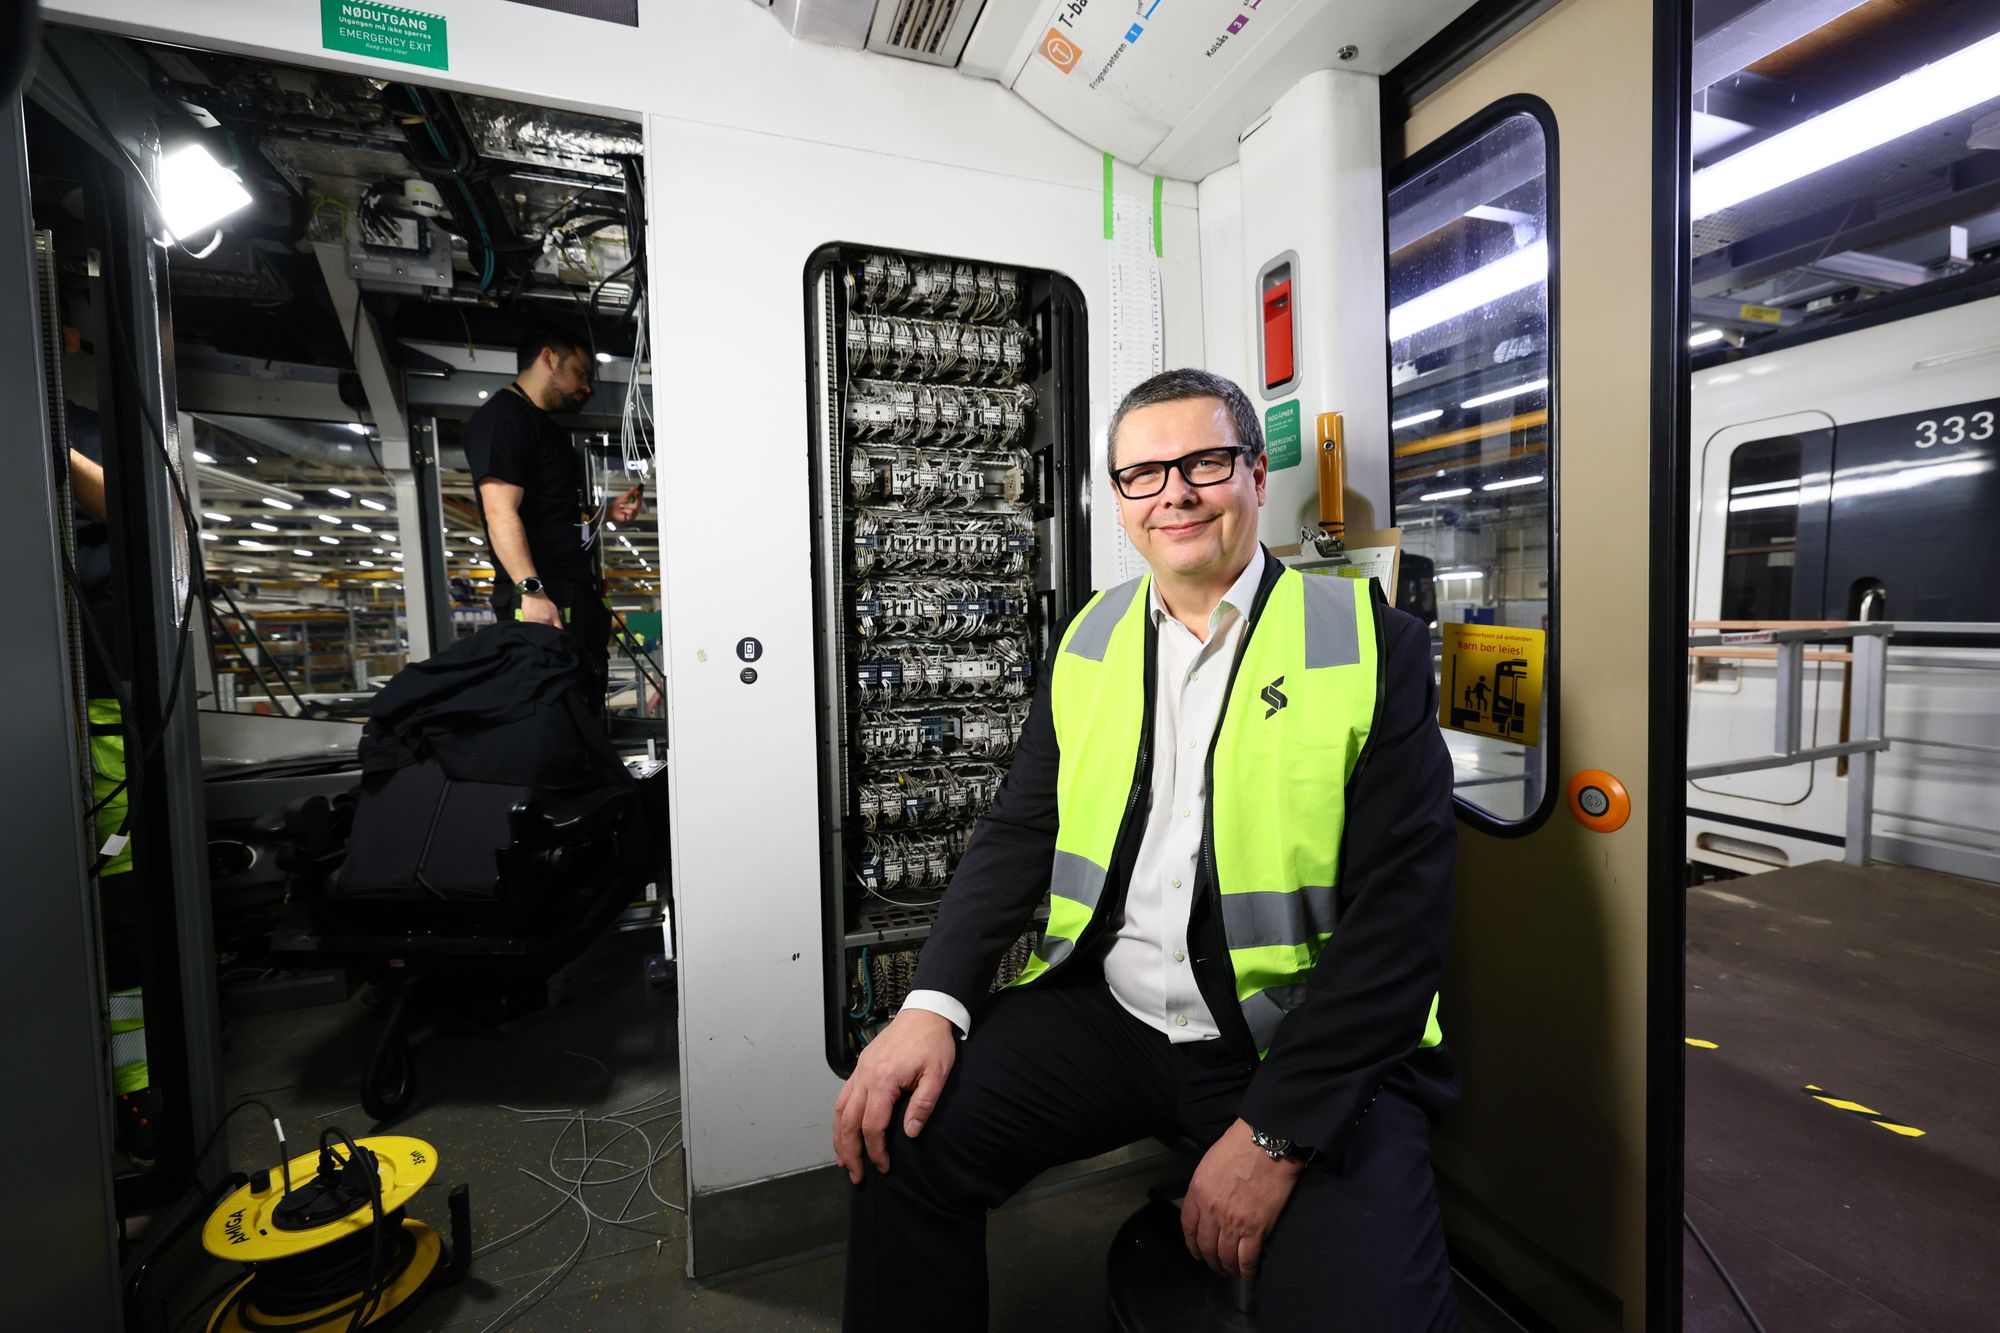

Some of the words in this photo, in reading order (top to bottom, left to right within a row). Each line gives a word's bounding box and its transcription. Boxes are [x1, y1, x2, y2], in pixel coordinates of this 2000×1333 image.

[338, 15, 374, 28] Utgangen
[388, 25, 403, 34] ikke
[342, 4, 428, 31] NØDUTGANG
[1233, 21, 1243, 29] 3
[339, 27, 406, 48] EMERGENCY
[409, 40, 432, 53] EXIT
[1205, 35, 1229, 58] Kolsås
[1089, 42, 1128, 90] Frognerseteren
[1914, 410, 1995, 449] 333
[1268, 434, 1297, 449] EMERGENCY
[1268, 444, 1287, 455] OPENER
[1457, 640, 1478, 651] Barn
[1480, 642, 1497, 653] bør
[1499, 643, 1524, 656] leies!
[224, 1208, 250, 1245] AMIGA
